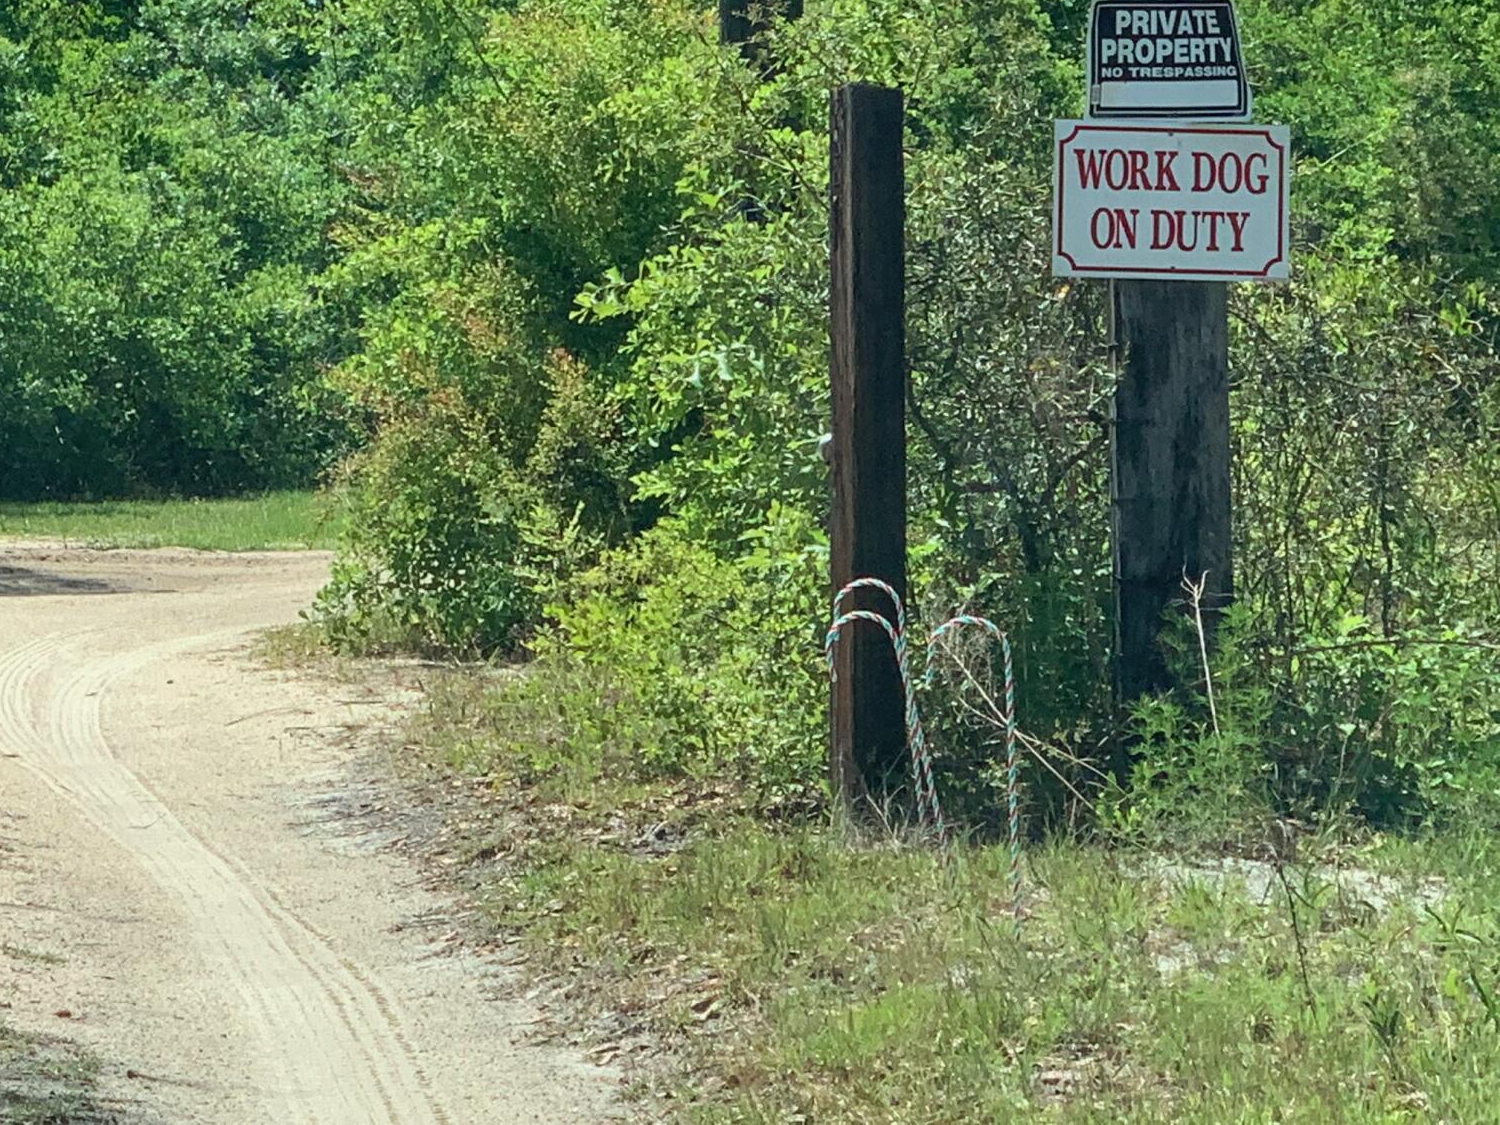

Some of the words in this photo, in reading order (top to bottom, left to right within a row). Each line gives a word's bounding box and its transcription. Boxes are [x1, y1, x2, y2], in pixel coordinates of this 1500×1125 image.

[1115, 9, 1220, 36] PRIVATE
[1101, 37, 1233, 64] PROPERTY
[1101, 67, 1123, 78] NO
[1128, 65, 1237, 78] TRESPASSING
[1073, 149, 1181, 192] WORK
[1191, 151, 1270, 194] DOG
[1090, 207, 1139, 249] ON
[1150, 209, 1250, 252] DUTY
